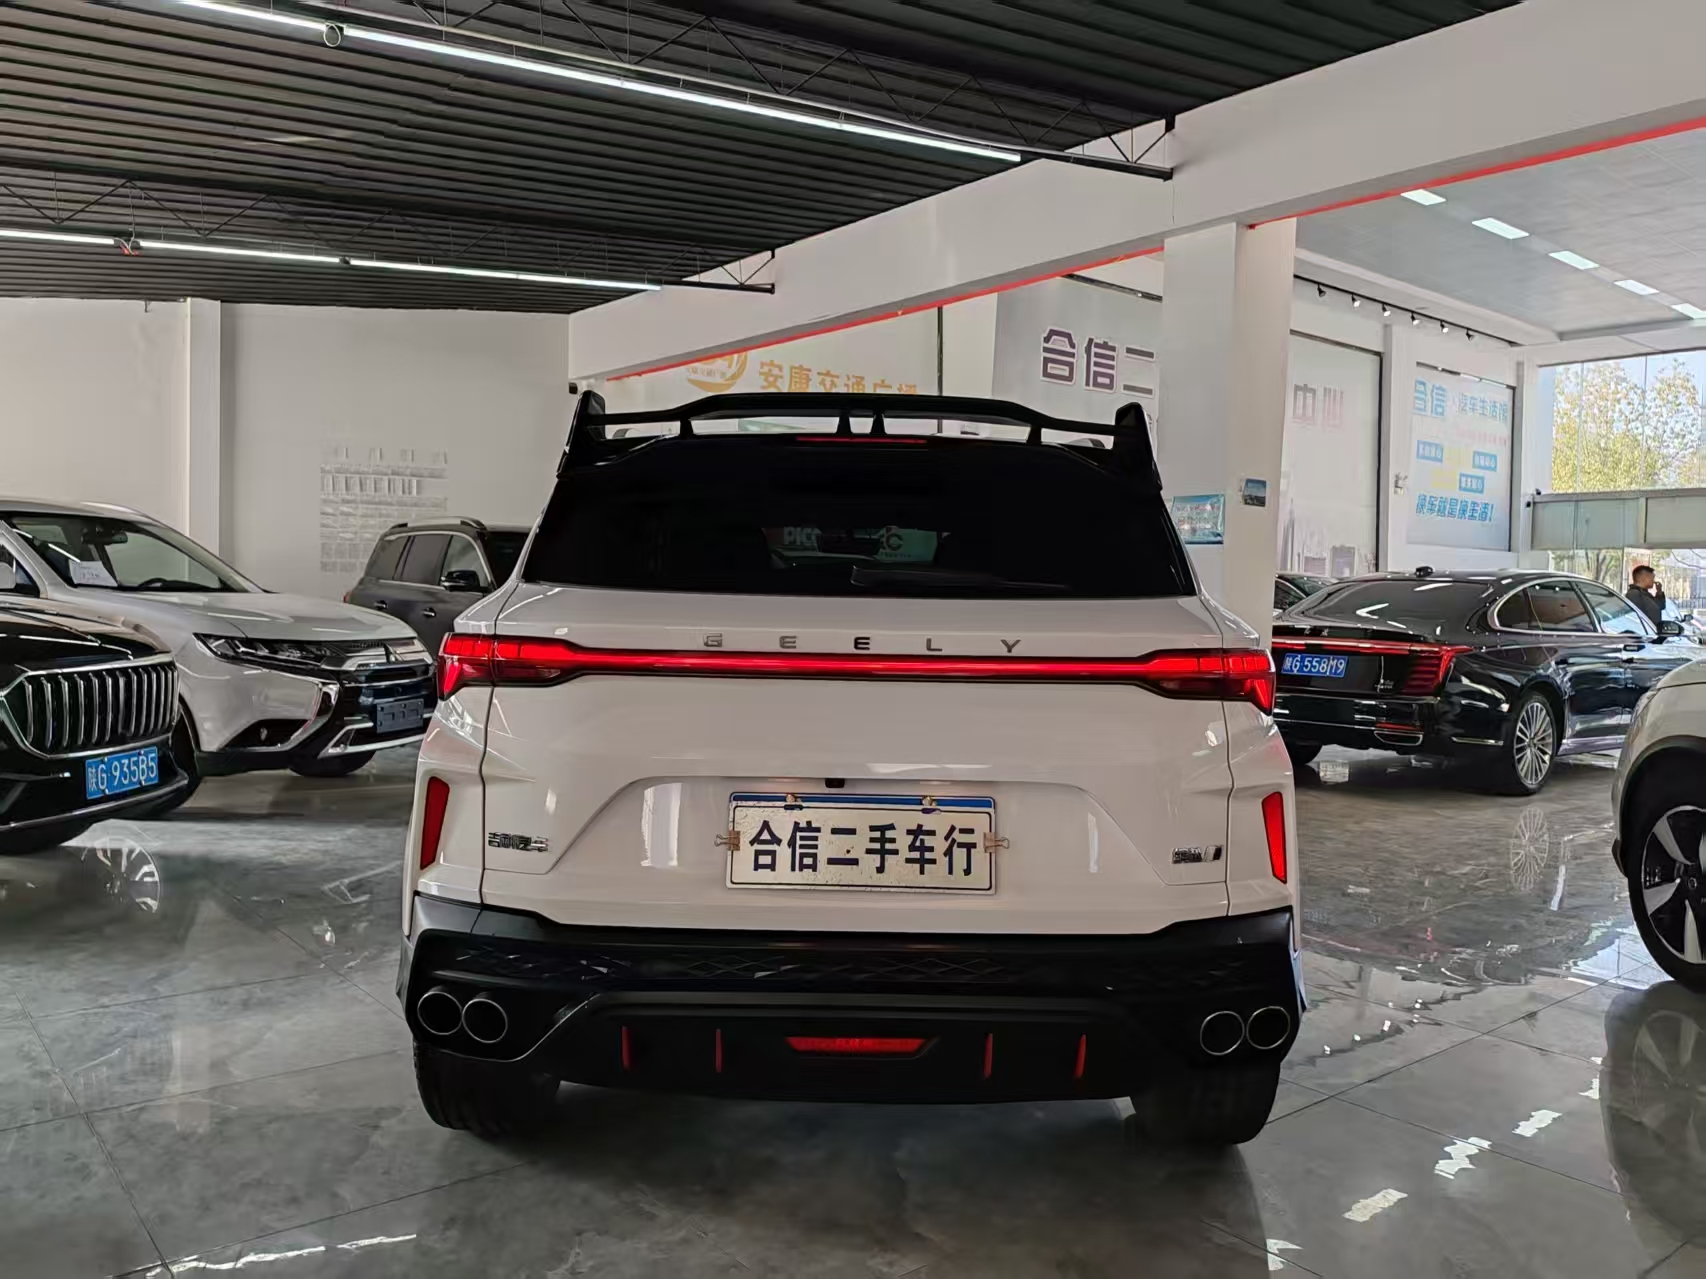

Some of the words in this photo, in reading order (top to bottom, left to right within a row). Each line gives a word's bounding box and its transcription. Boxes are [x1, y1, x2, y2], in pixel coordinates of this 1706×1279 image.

[703, 632, 1021, 653] GEELY
[748, 819, 978, 877] 合信二手车行
